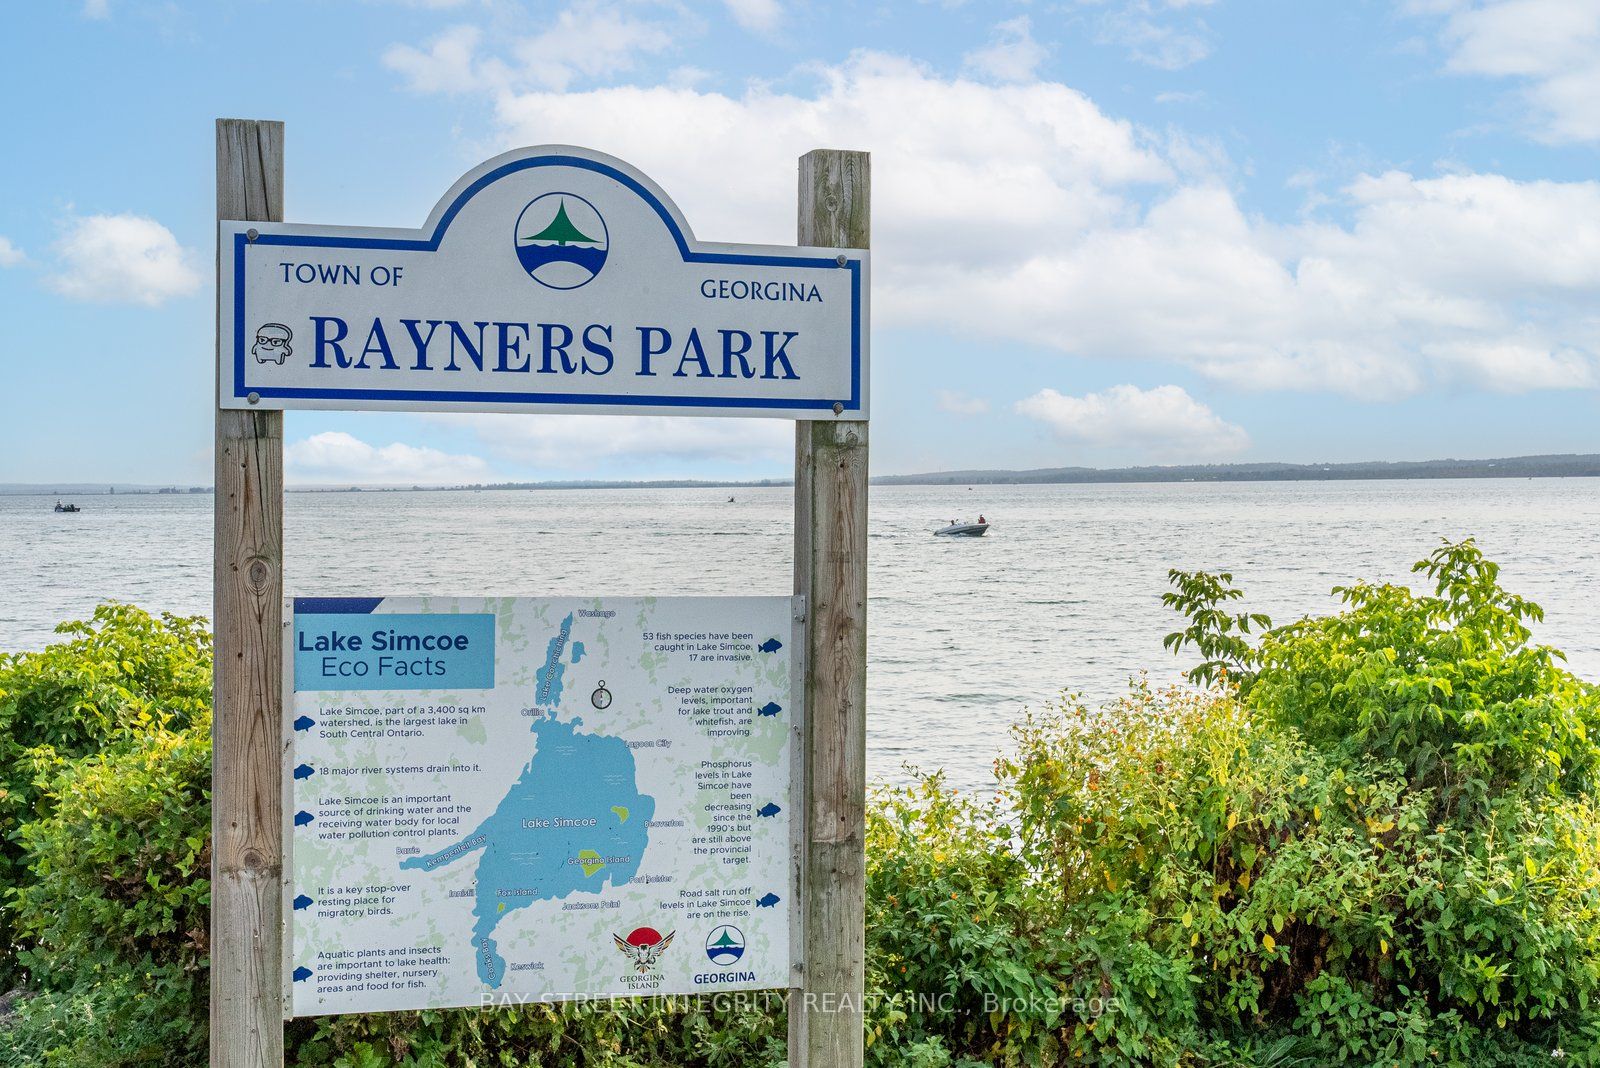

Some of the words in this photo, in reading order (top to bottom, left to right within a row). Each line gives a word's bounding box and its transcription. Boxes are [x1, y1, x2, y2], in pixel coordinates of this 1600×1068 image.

[279, 263, 360, 284] TOWN
[370, 266, 403, 286] OF
[700, 279, 822, 302] GEORGINA
[309, 316, 613, 375] RAYNERS
[635, 326, 800, 380] PARK
[299, 631, 362, 651] Lake
[371, 630, 468, 650] Simcoe
[643, 632, 653, 640] 53
[656, 632, 671, 640] fish
[674, 632, 706, 642] species
[708, 632, 729, 640] have
[732, 632, 753, 640] been
[654, 643, 684, 652] caught
[686, 643, 694, 651] in
[720, 643, 752, 651] Simcoe.
[716, 653, 752, 661] invasive.
[322, 657, 368, 676] Eco
[379, 656, 445, 676] Facts
[668, 686, 691, 695] Deep
[695, 686, 718, 694] water
[720, 686, 752, 694] oxygen
[682, 696, 708, 706] levels,
[710, 696, 752, 706] important
[345, 707, 382, 716] Simcoe,
[385, 707, 404, 717] part
[407, 706, 416, 714] of
[428, 706, 455, 714] 3,400
[458, 707, 468, 716] sq
[678, 707, 690, 716] for
[693, 707, 710, 715] lake
[736, 706, 752, 714] and
[320, 718, 372, 726] watershed,
[375, 718, 382, 726] is
[404, 718, 435, 726] largest
[460, 716, 467, 724] in
[695, 717, 736, 725] whitefish,
[320, 730, 347, 738] South
[350, 729, 384, 737] Central
[386, 729, 424, 737] Ontario.
[707, 728, 751, 737] improving.
[701, 760, 752, 770] Phosphorus
[319, 767, 329, 775] 18
[332, 768, 358, 776] major
[362, 766, 382, 774] river
[385, 766, 423, 775] systems
[695, 771, 719, 779] levels
[722, 770, 729, 778] in
[698, 782, 728, 790] Simcoe
[319, 797, 341, 805] Lake
[344, 796, 378, 804] Simcoe
[381, 795, 388, 803] is
[405, 795, 450, 804] important
[353, 807, 363, 815] of
[366, 807, 403, 816] drinking
[407, 806, 433, 814] water
[436, 805, 453, 813] and
[704, 802, 751, 813] decreasing
[318, 819, 362, 829] receiving
[394, 818, 418, 827] body
[422, 816, 434, 824] for
[438, 816, 459, 824] local
[522, 817, 549, 829] Lake
[553, 816, 597, 828] Simcoe
[707, 824, 734, 832] 1990's
[348, 830, 389, 840] pollution
[392, 828, 425, 837] control
[428, 828, 458, 837] plants.
[708, 835, 722, 843] still
[710, 845, 751, 856] provincial
[723, 856, 750, 865] target.
[346, 886, 362, 895] key
[366, 885, 410, 895] stop-over
[680, 889, 702, 897] Road
[738, 887, 751, 895] off
[318, 898, 350, 907] resting
[354, 897, 379, 907] place
[382, 895, 395, 904] for
[660, 901, 684, 909] levels
[318, 909, 364, 918] migratory
[367, 907, 393, 915] birds.
[318, 950, 354, 960] Aquatic
[357, 949, 385, 958] plants
[388, 947, 406, 956] and
[409, 946, 441, 956] insects
[335, 960, 381, 971] important
[397, 958, 416, 966] lake
[419, 956, 450, 965] health:
[317, 972, 363, 983] providing
[365, 971, 399, 981] shelter,
[402, 970, 437, 980] nursery
[619, 974, 665, 983] GEORGINA
[694, 972, 755, 984] GEORGINA
[346, 983, 363, 991] and
[366, 982, 388, 990] food
[408, 980, 426, 988] fish.
[628, 982, 659, 990] ISLAND
